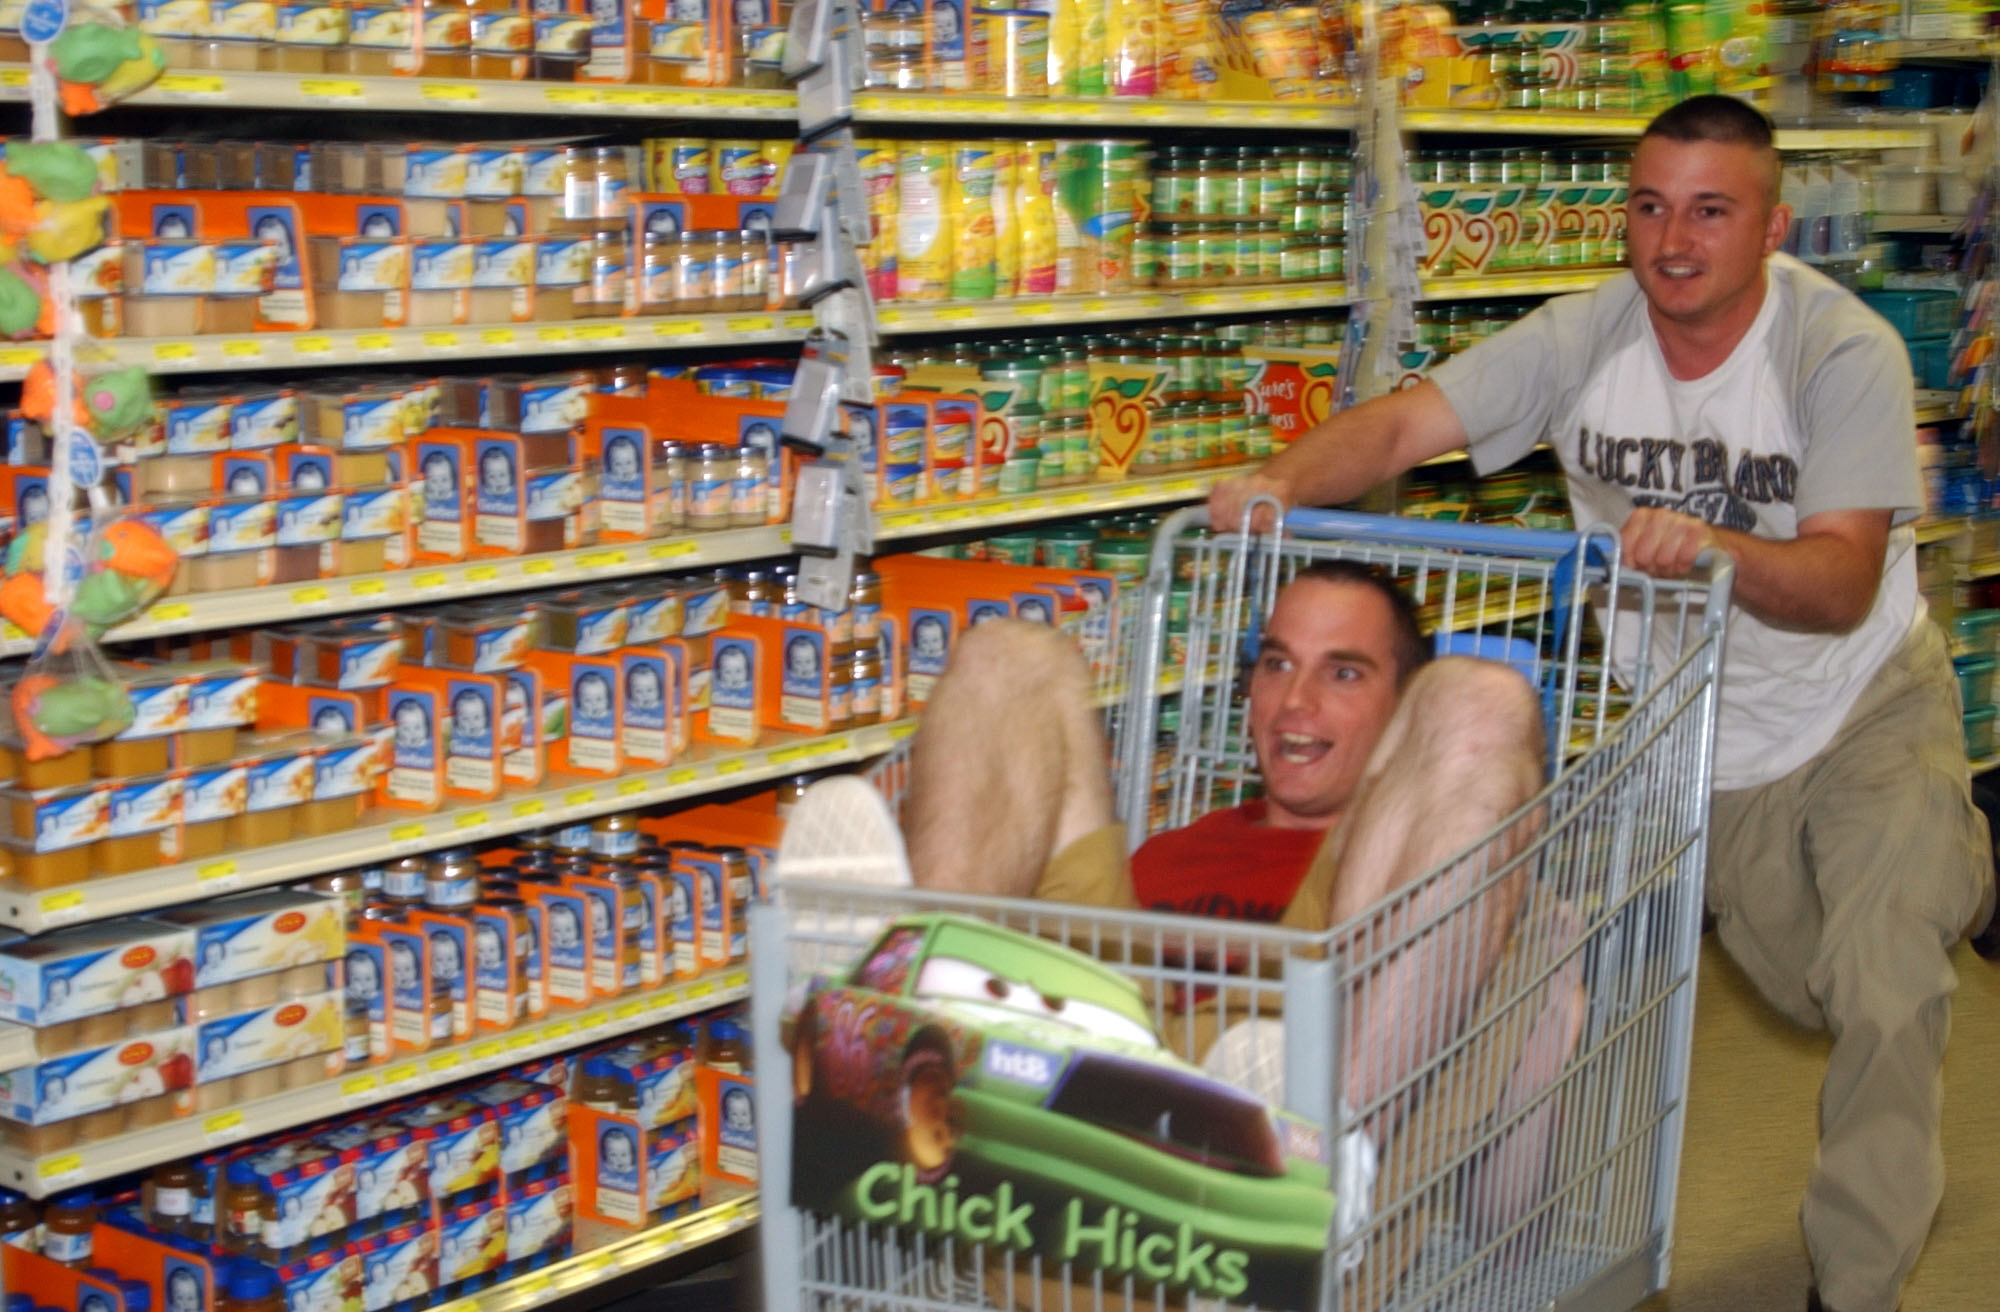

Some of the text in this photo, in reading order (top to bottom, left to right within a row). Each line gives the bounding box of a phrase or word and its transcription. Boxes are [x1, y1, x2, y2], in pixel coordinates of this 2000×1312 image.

[1580, 425, 1686, 493] LUCKY
[857, 1162, 1250, 1296] Chick Hicks
